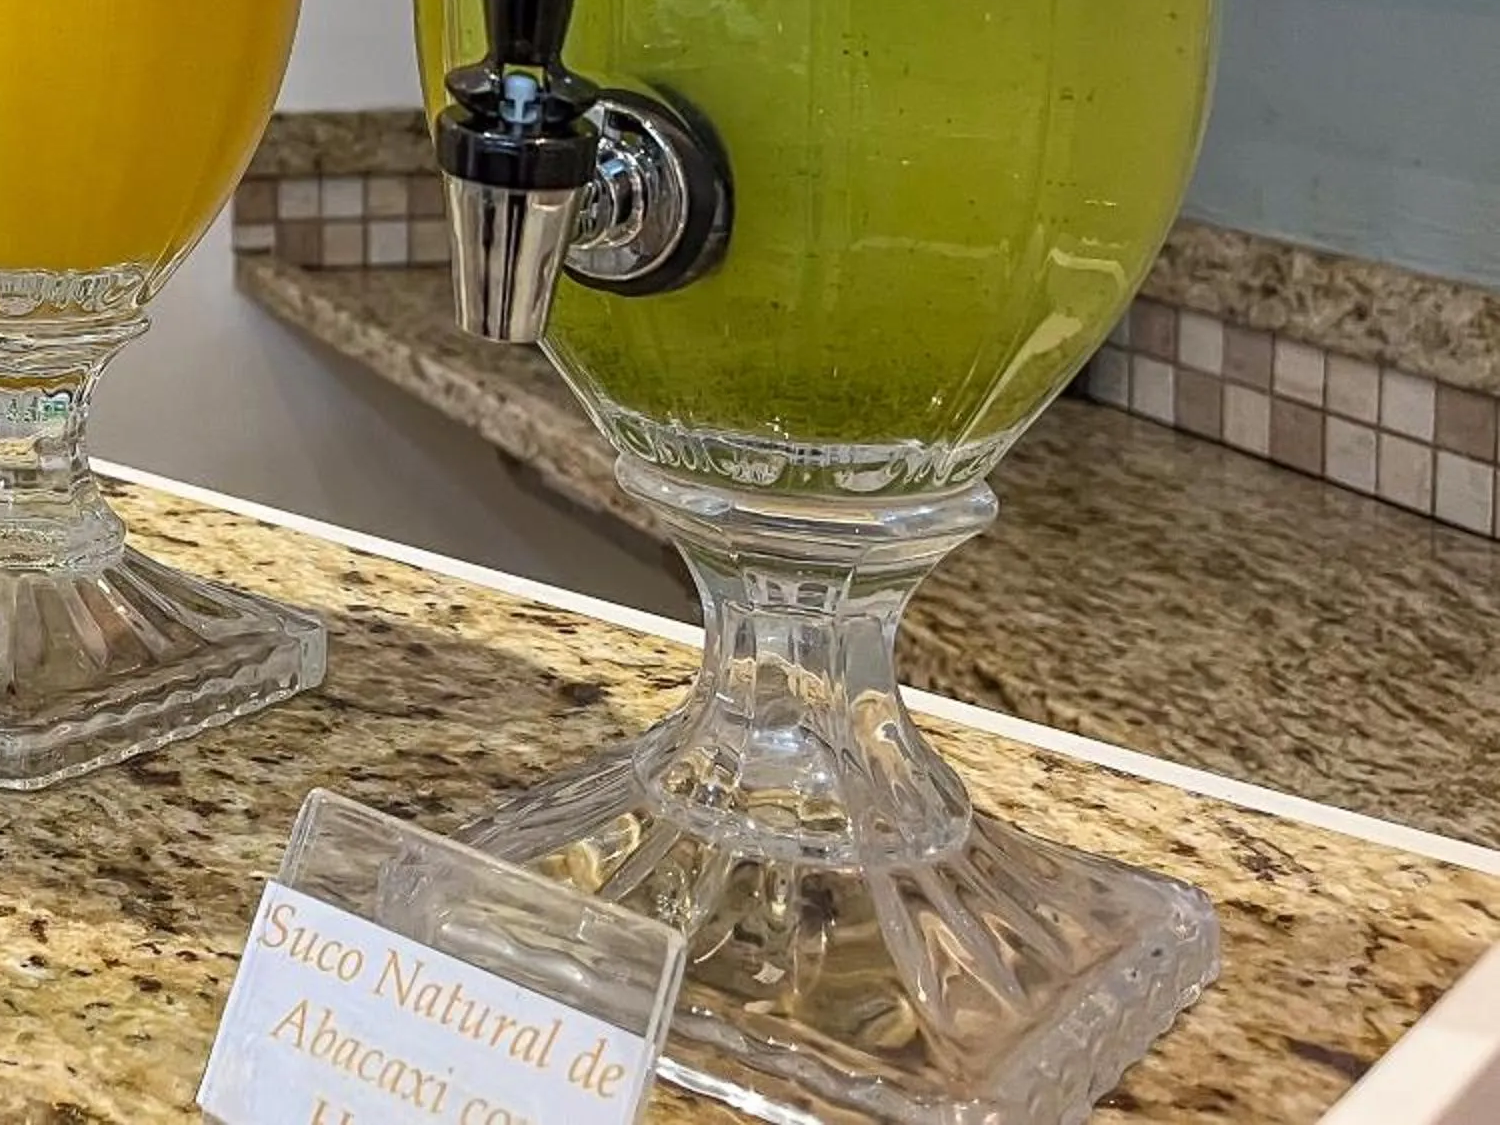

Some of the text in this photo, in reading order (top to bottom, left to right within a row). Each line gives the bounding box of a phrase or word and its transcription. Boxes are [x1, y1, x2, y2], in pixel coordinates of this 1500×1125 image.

[257, 903, 626, 1100] Suco Natural de
[271, 998, 537, 1125] Abacaxi co
